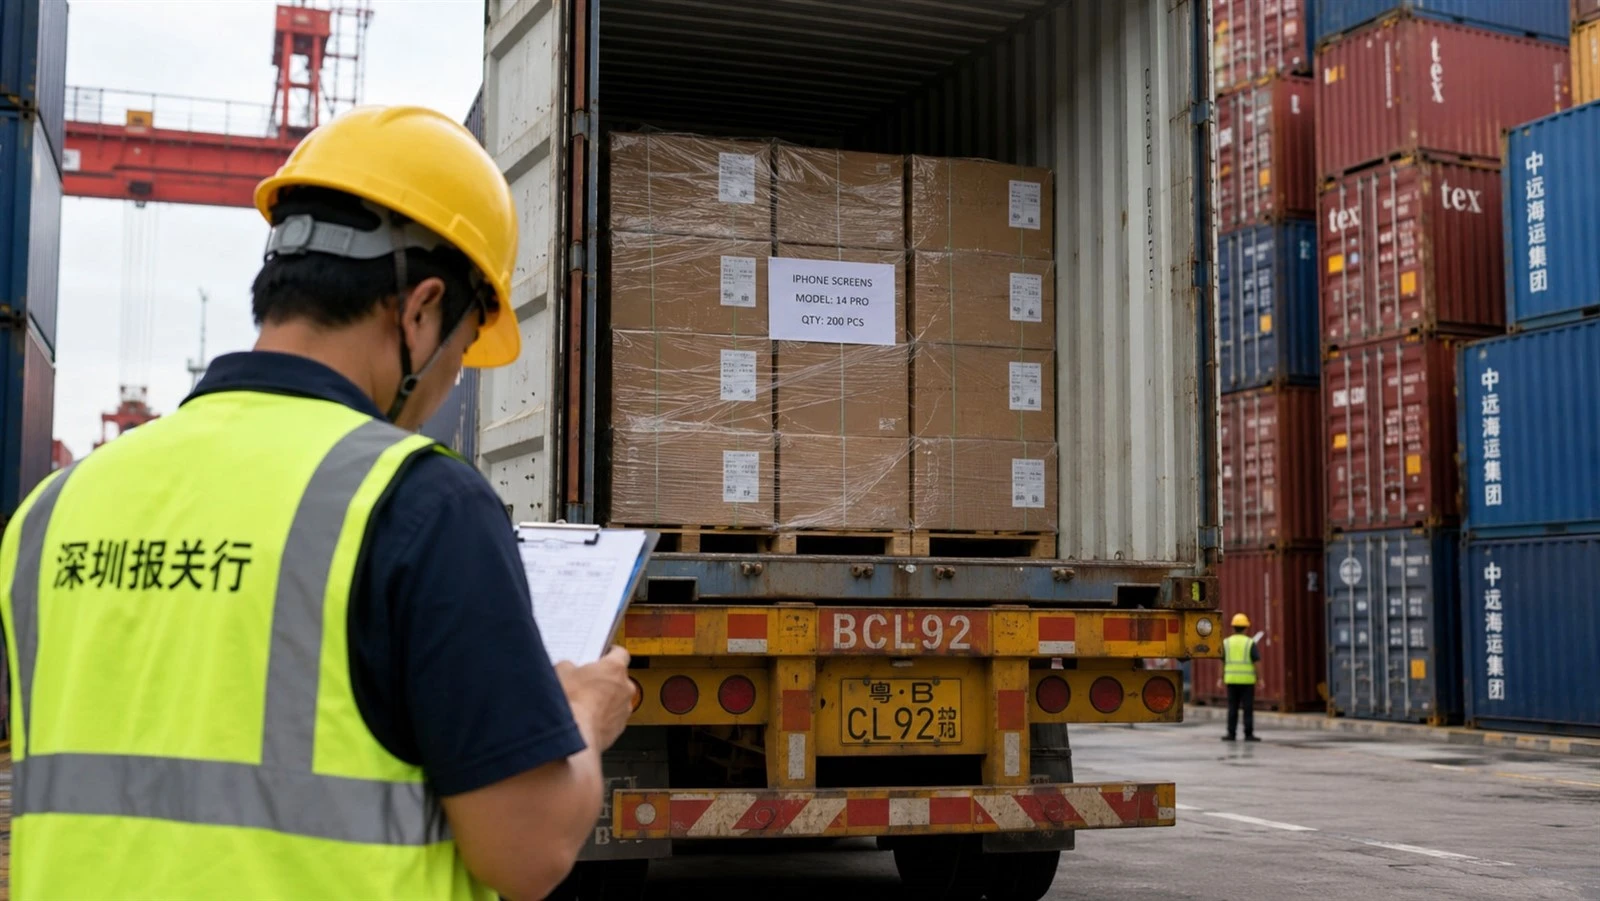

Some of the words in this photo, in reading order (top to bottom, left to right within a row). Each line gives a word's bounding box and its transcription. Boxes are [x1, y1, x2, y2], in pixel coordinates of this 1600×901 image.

[1430, 36, 1444, 104] tex
[1441, 181, 1482, 214] tex
[1328, 205, 1360, 233] tex
[1525, 150, 1548, 293] 中远海运集团
[792, 274, 829, 285] IPHONE
[831, 276, 873, 287] SCREENS
[795, 293, 833, 304] MODEL:
[836, 296, 847, 305] 14
[850, 296, 870, 306] PRO
[801, 315, 824, 325] QTY:
[826, 316, 844, 326] 200
[847, 317, 865, 327] PCS
[1481, 367, 1502, 506] 中远海运集团
[54, 539, 253, 592] 深圳报关行
[833, 613, 971, 650] BCL92
[1484, 561, 1504, 700] 中远海运集团
[869, 682, 934, 704] 粤·B
